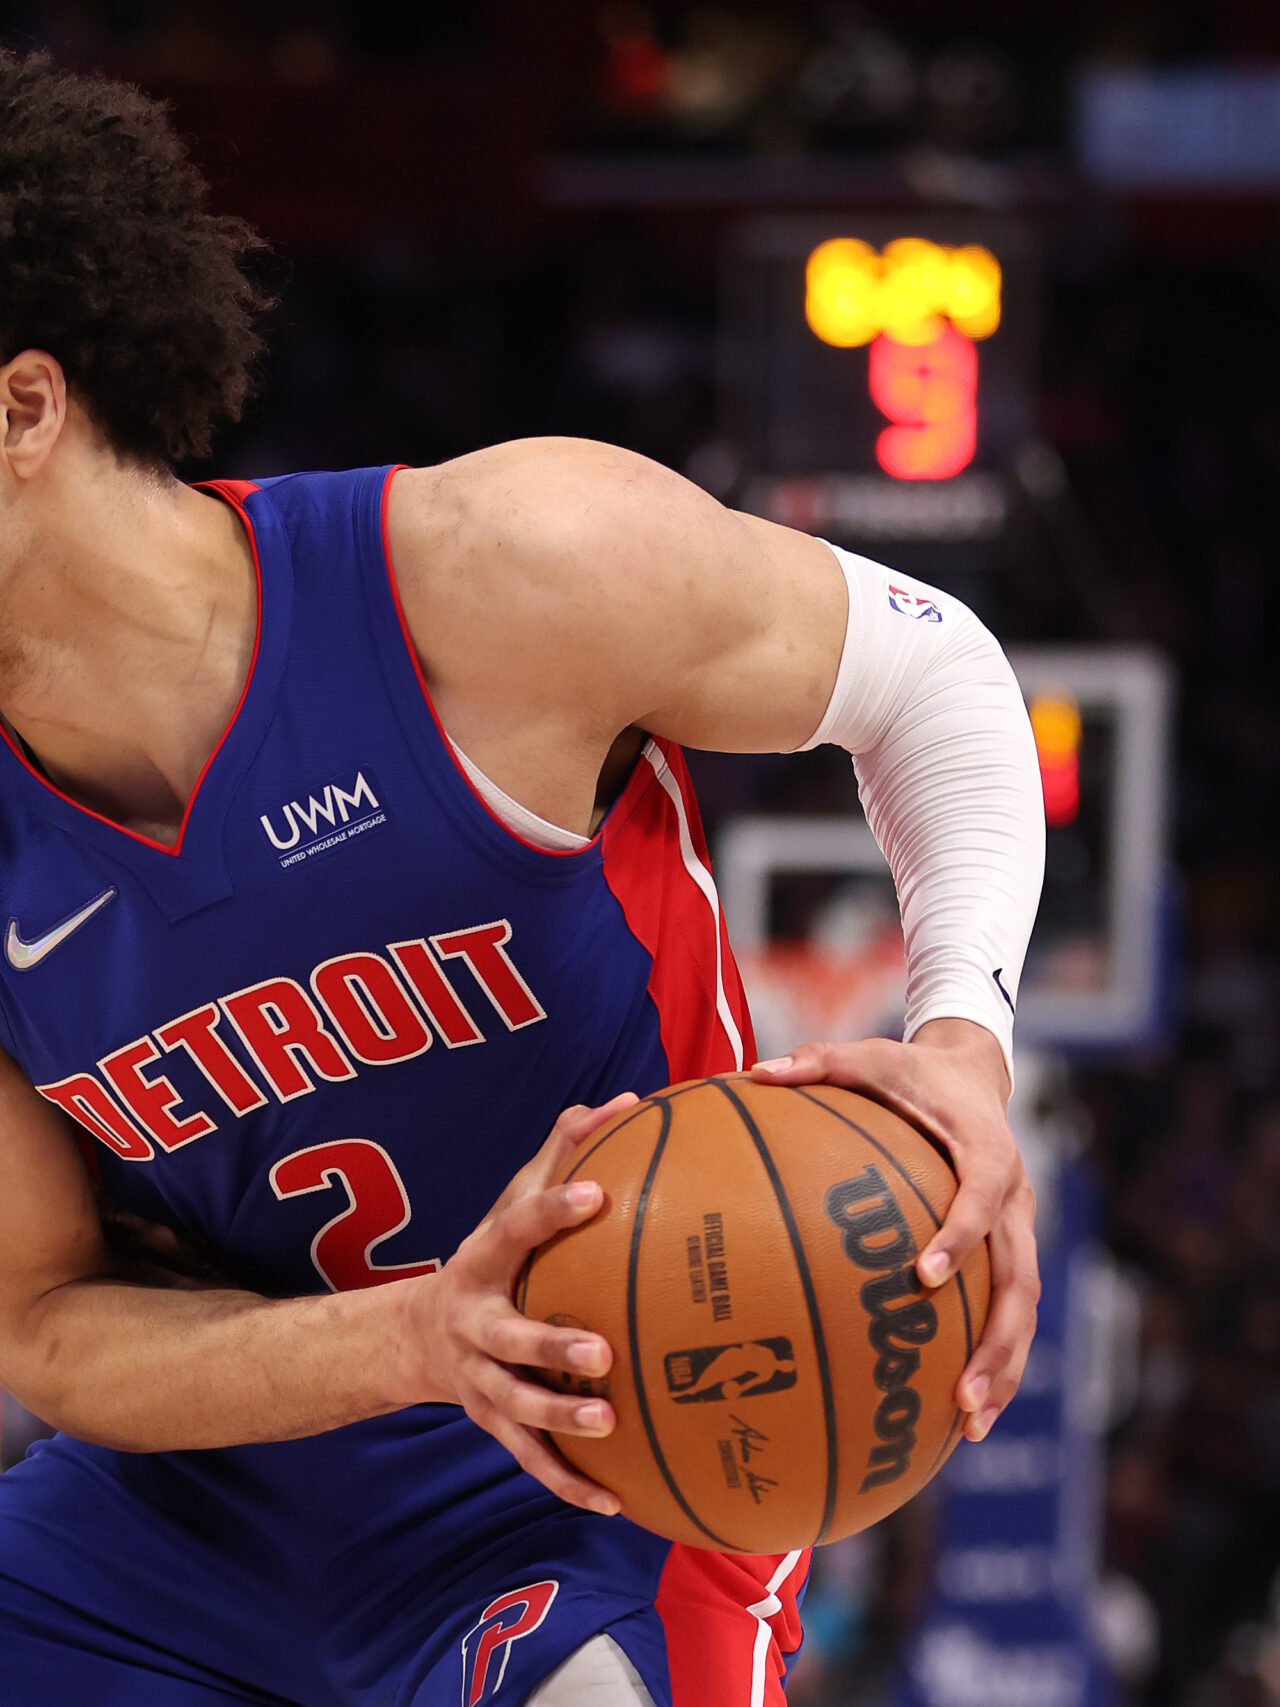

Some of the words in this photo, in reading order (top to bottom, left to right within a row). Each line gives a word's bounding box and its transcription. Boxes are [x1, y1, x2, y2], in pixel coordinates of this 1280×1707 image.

[260, 771, 380, 850] UWM
[280, 852, 306, 868] UNITED
[306, 832, 348, 856] WHOLESALE
[348, 813, 387, 837] MORTGAGE
[35, 918, 548, 1162] DETROIT
[269, 1138, 442, 1293] 2
[824, 1163, 939, 1495] Wilson
